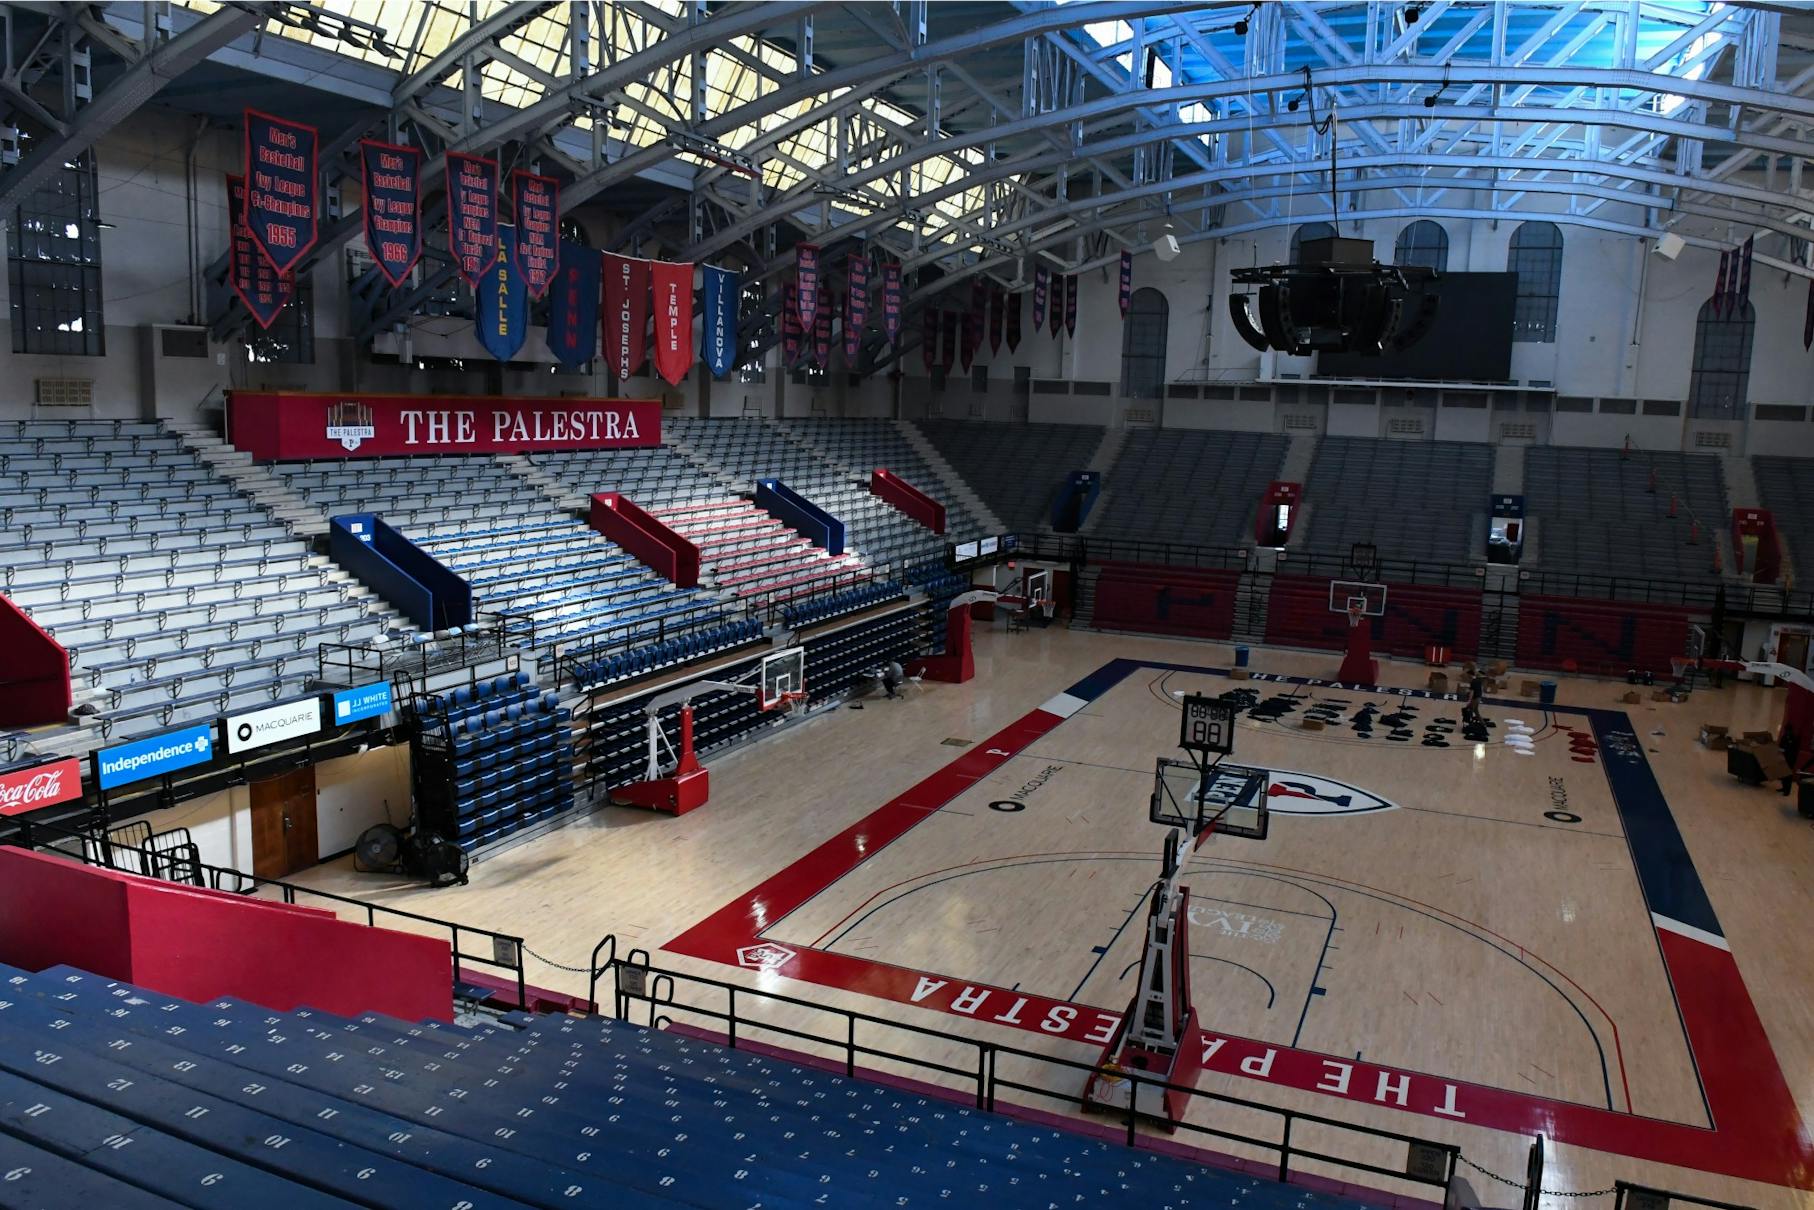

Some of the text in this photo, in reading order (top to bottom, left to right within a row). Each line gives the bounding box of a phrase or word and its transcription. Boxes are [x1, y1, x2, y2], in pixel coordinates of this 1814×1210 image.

[268, 126, 297, 149] Men's
[259, 145, 305, 172] Basketball
[274, 175, 306, 198] League
[373, 172, 412, 192] Basketball
[373, 215, 413, 234] Champions
[266, 223, 297, 248] 1955
[382, 242, 408, 263] 1966
[497, 238, 508, 336] LA SALLE
[668, 283, 678, 351] TEMPLE
[715, 274, 725, 368] VILLANOVA
[330, 428, 371, 437] THE PALESTRA
[400, 409, 640, 445] THE PALESTRA
[1252, 672, 1288, 682] HE
[363, 691, 387, 704] WHITE
[255, 711, 313, 733] MACQUARIE
[102, 740, 193, 775] Independence
[49, 1020, 71, 1029] 15
[213, 1019, 231, 1027] 16
[166, 1026, 186, 1035] 15
[108, 1040, 132, 1050] 14
[268, 1035, 286, 1044] 15
[225, 1045, 245, 1054] 14
[368, 1047, 385, 1055] 13
[910, 977, 1466, 1118] THE PAESTRA
[41, 1051, 62, 1064] 13
[173, 1061, 197, 1072] 13
[287, 1064, 308, 1073] 13
[385, 1069, 404, 1079] 13
[107, 1079, 133, 1091] 12
[484, 1079, 498, 1087] 11
[243, 1084, 266, 1094] 12
[354, 1085, 374, 1094] 12
[449, 1089, 468, 1098] 12
[542, 1096, 559, 1104] 10
[24, 1103, 51, 1117] 11
[185, 1106, 209, 1118] 11
[318, 1108, 339, 1119] 11
[425, 1106, 443, 1116] 11
[517, 1108, 533, 1117] 11
[495, 1128, 516, 1139] 10
[581, 1127, 600, 1136] 10
[103, 1135, 134, 1149] 10
[264, 1135, 291, 1148] 10
[389, 1132, 412, 1143] 10
[577, 1152, 591, 1161] 9
[657, 1148, 670, 1157] 9
[745, 1154, 756, 1162] 7
[475, 1158, 492, 1168] 9
[4, 1167, 31, 1181] 9
[357, 1168, 376, 1179] 9
[734, 1170, 748, 1179] 8
[201, 1173, 223, 1186] 9
[659, 1177, 675, 1186] 8
[564, 1185, 582, 1197] 8
[815, 1194, 828, 1203] 7
[452, 1201, 473, 1210] 8
